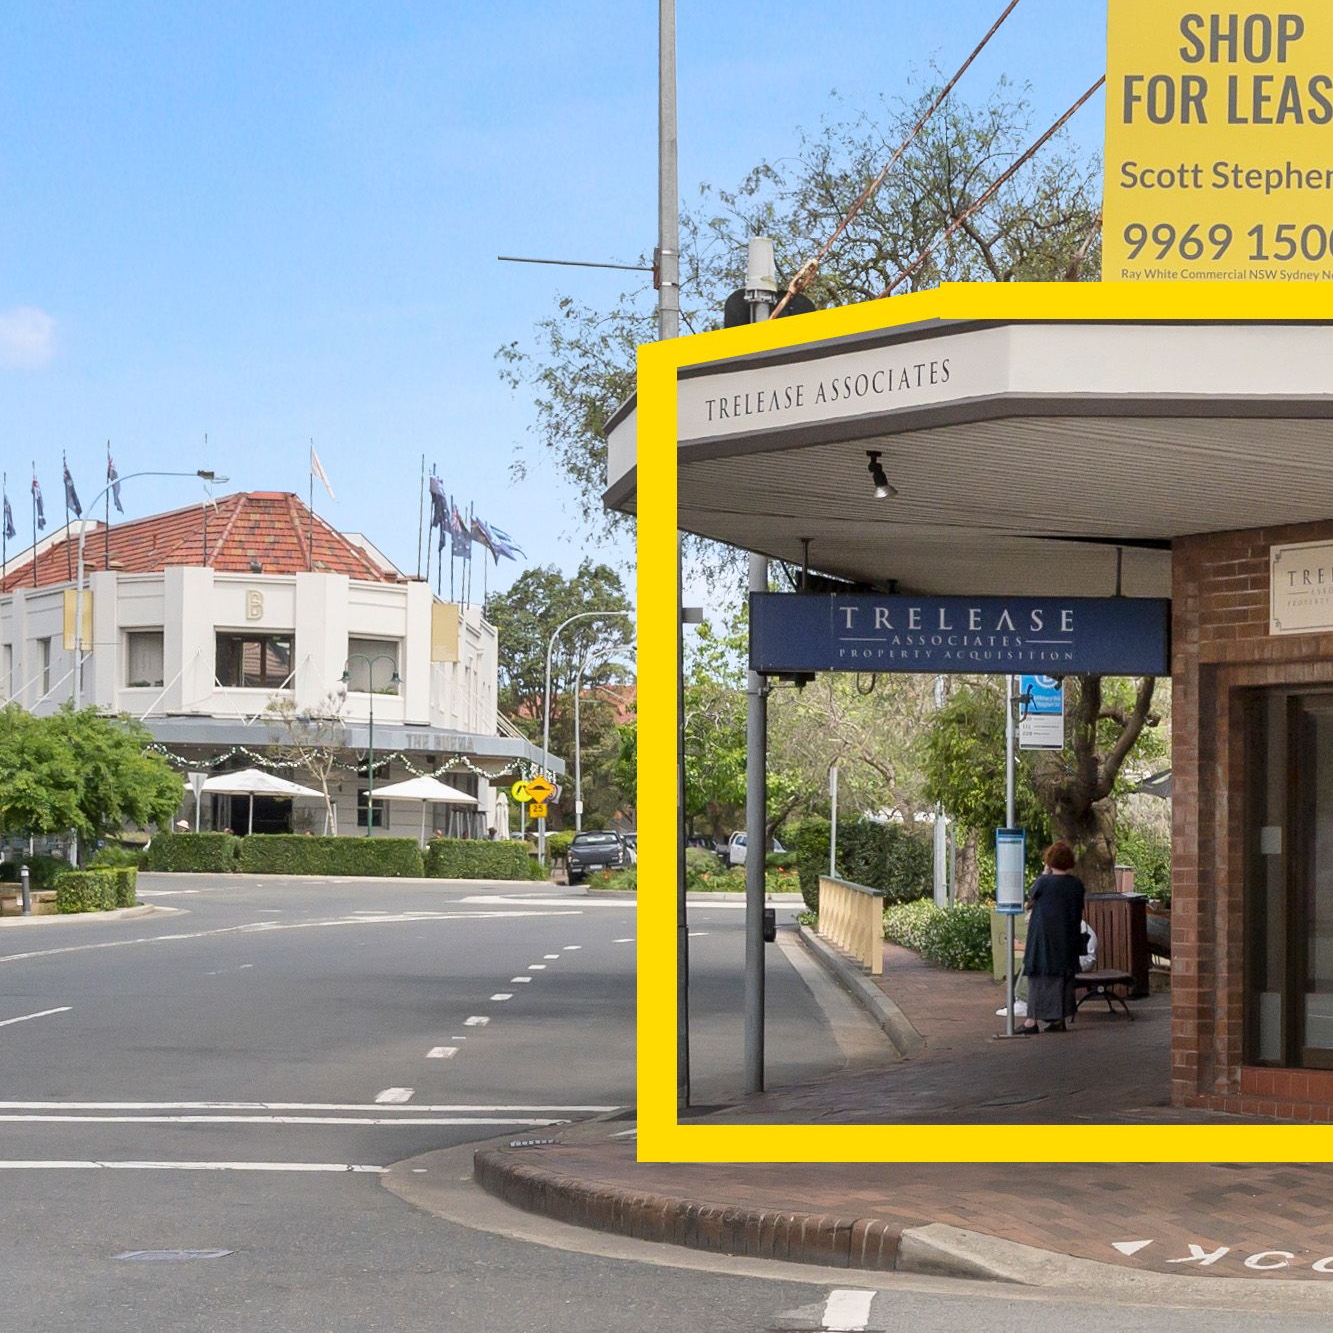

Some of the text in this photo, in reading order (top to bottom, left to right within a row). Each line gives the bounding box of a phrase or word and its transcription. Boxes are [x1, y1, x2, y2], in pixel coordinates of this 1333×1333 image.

[1179, 13, 1305, 64] SHOP
[1123, 74, 1209, 125] FOR
[1120, 161, 1203, 189] Scott
[1123, 222, 1233, 261] 9969
[1121, 268, 1142, 280] Ray
[1144, 268, 1178, 279] White
[1180, 268, 1247, 279] Commercial
[1249, 270, 1277, 279] NSW
[1279, 269, 1320, 282] Sydney
[705, 358, 950, 421] TRELEASE ASSOCIATES
[839, 606, 1074, 632] TRELEASE
[891, 634, 1023, 647] ASSOCIATES
[839, 648, 1074, 661] PROPERTY ACQUISITION
[533, 804, 544, 813] 25
